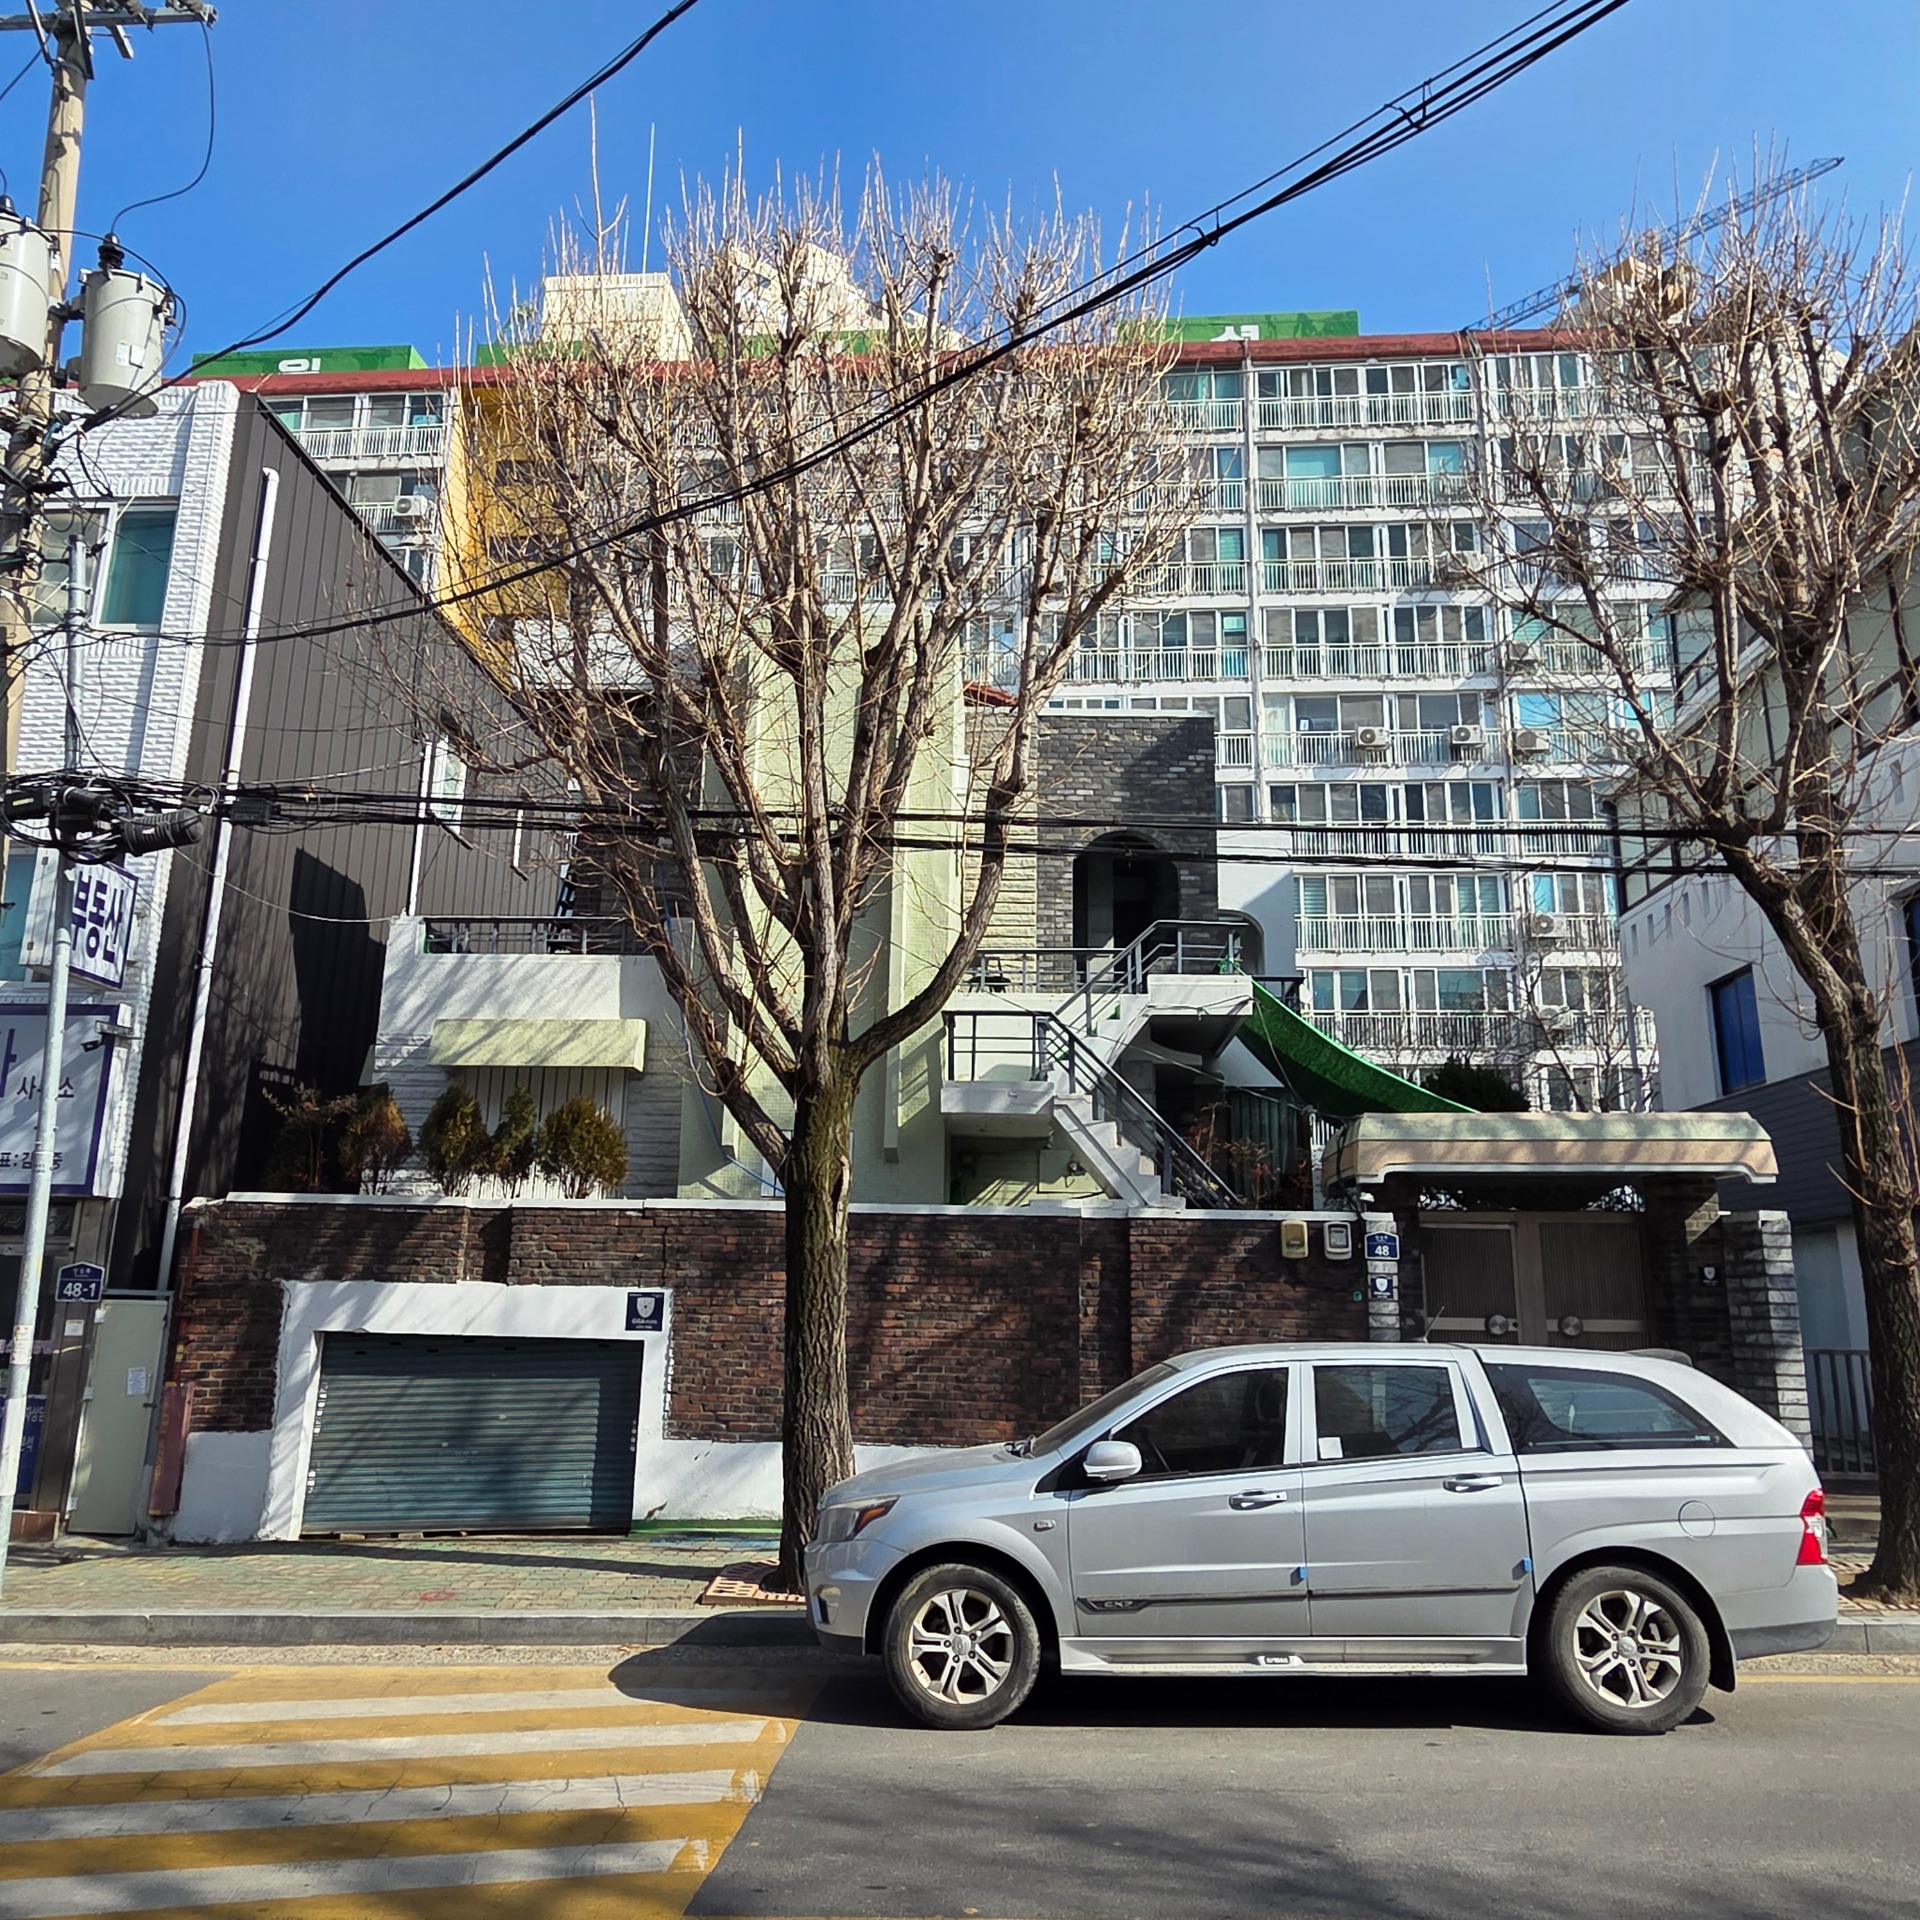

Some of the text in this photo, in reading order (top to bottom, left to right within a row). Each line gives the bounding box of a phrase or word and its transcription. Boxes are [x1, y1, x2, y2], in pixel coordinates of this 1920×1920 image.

[71, 870, 123, 964] 부동산
[16, 1075, 75, 1100] 사소
[1375, 1245, 1390, 1256] 48
[63, 1282, 96, 1297] 48-1
